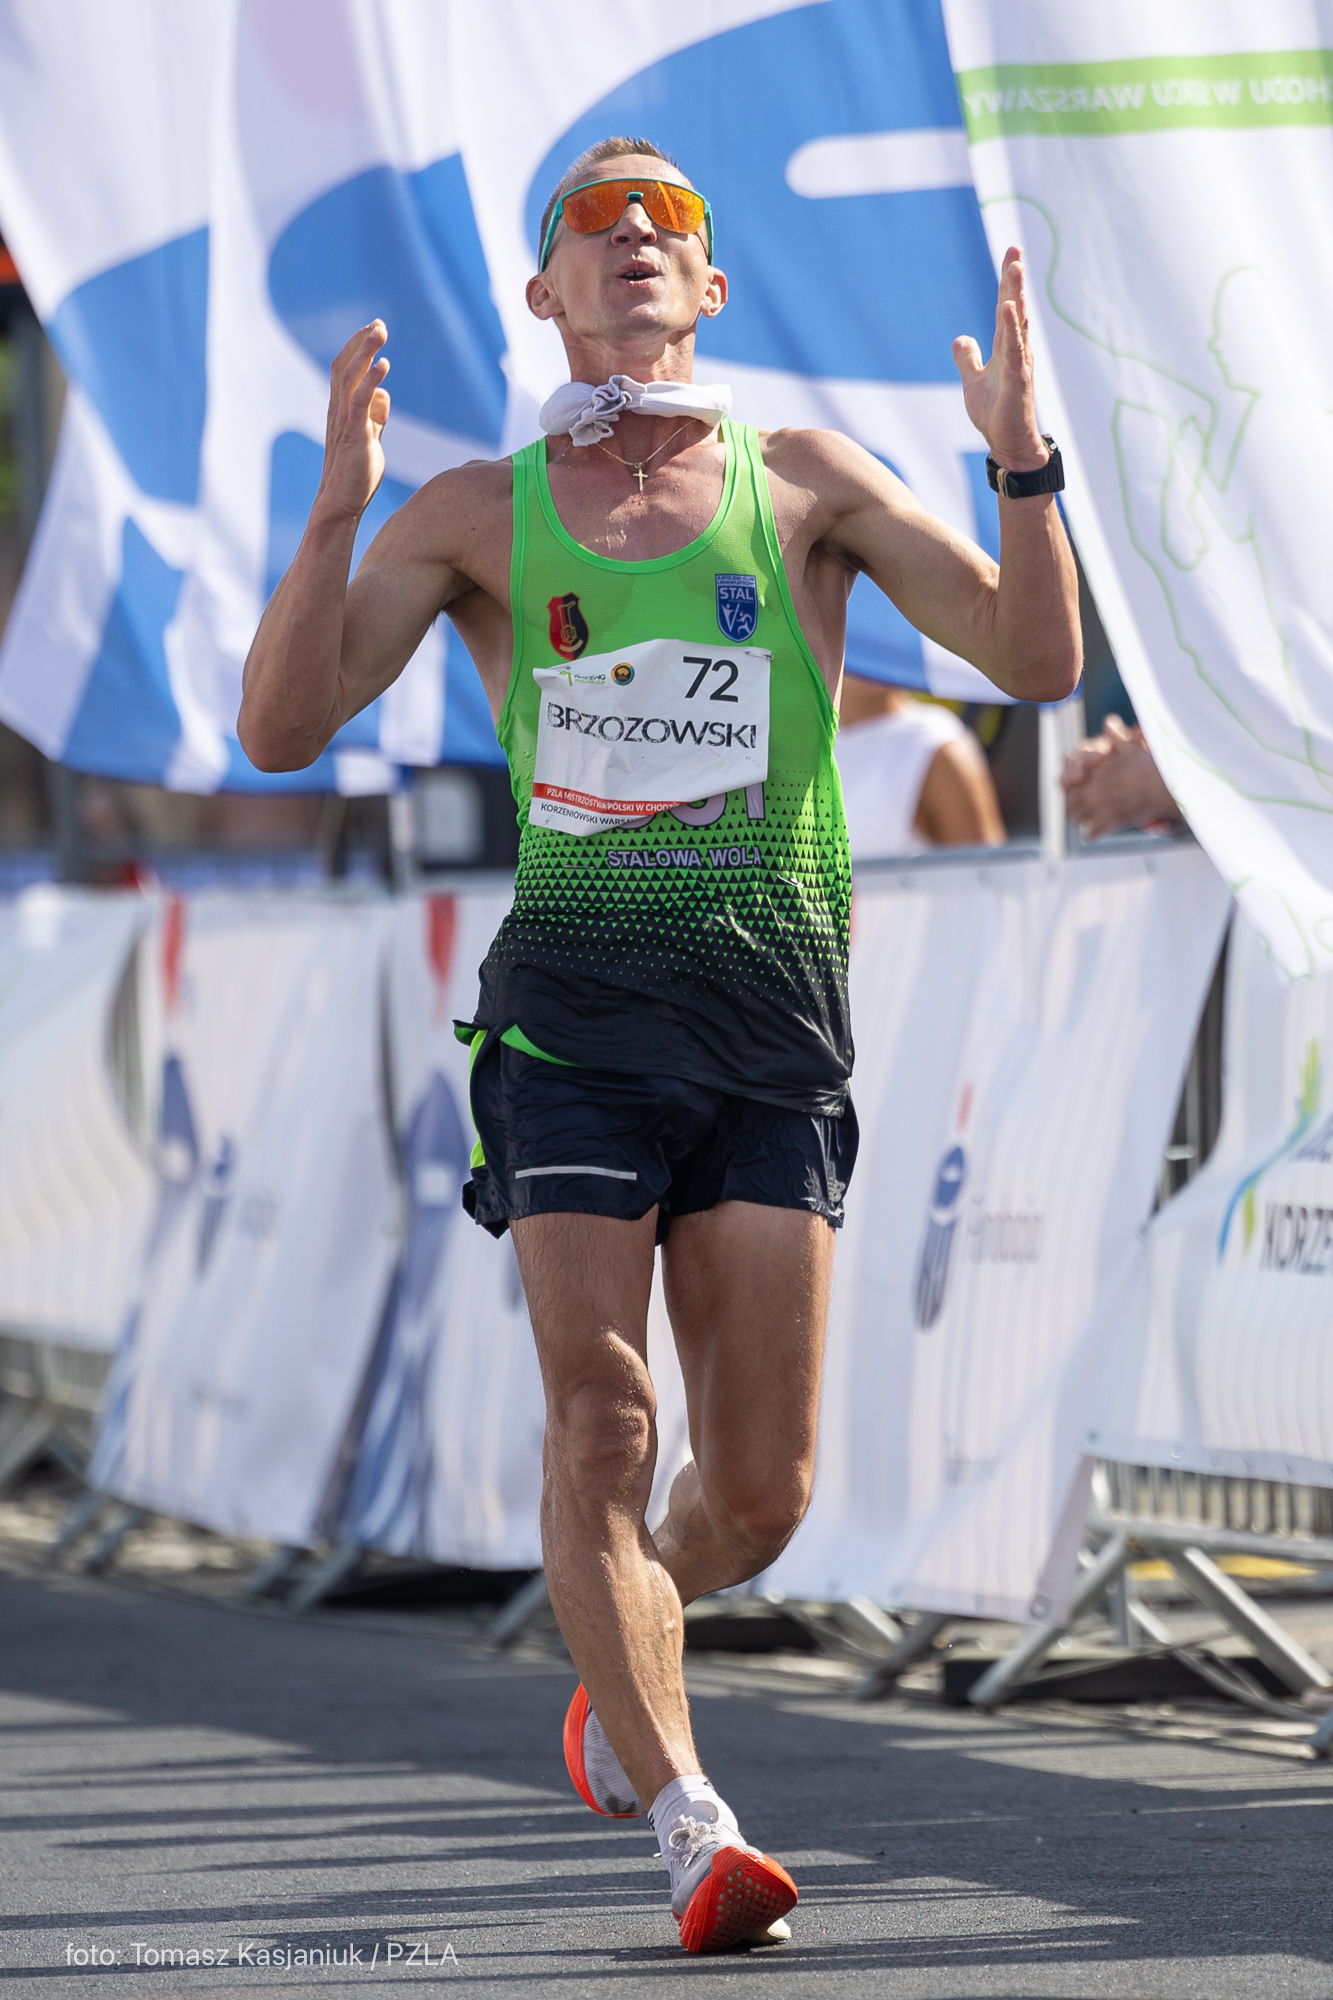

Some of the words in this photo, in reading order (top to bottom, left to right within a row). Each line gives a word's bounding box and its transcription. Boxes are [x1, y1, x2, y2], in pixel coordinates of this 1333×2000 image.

[719, 587, 754, 600] STAL
[682, 655, 739, 703] 72
[546, 701, 757, 749] BRZOZOWSKI
[546, 787, 563, 799] PZLA
[563, 791, 606, 809] MISTRZOSTWA
[607, 802, 634, 812] POLSKI
[635, 803, 644, 812] W
[540, 803, 598, 824] KORZENIOWSKI
[607, 849, 702, 868] STALOWA
[708, 846, 762, 867] WOLA
